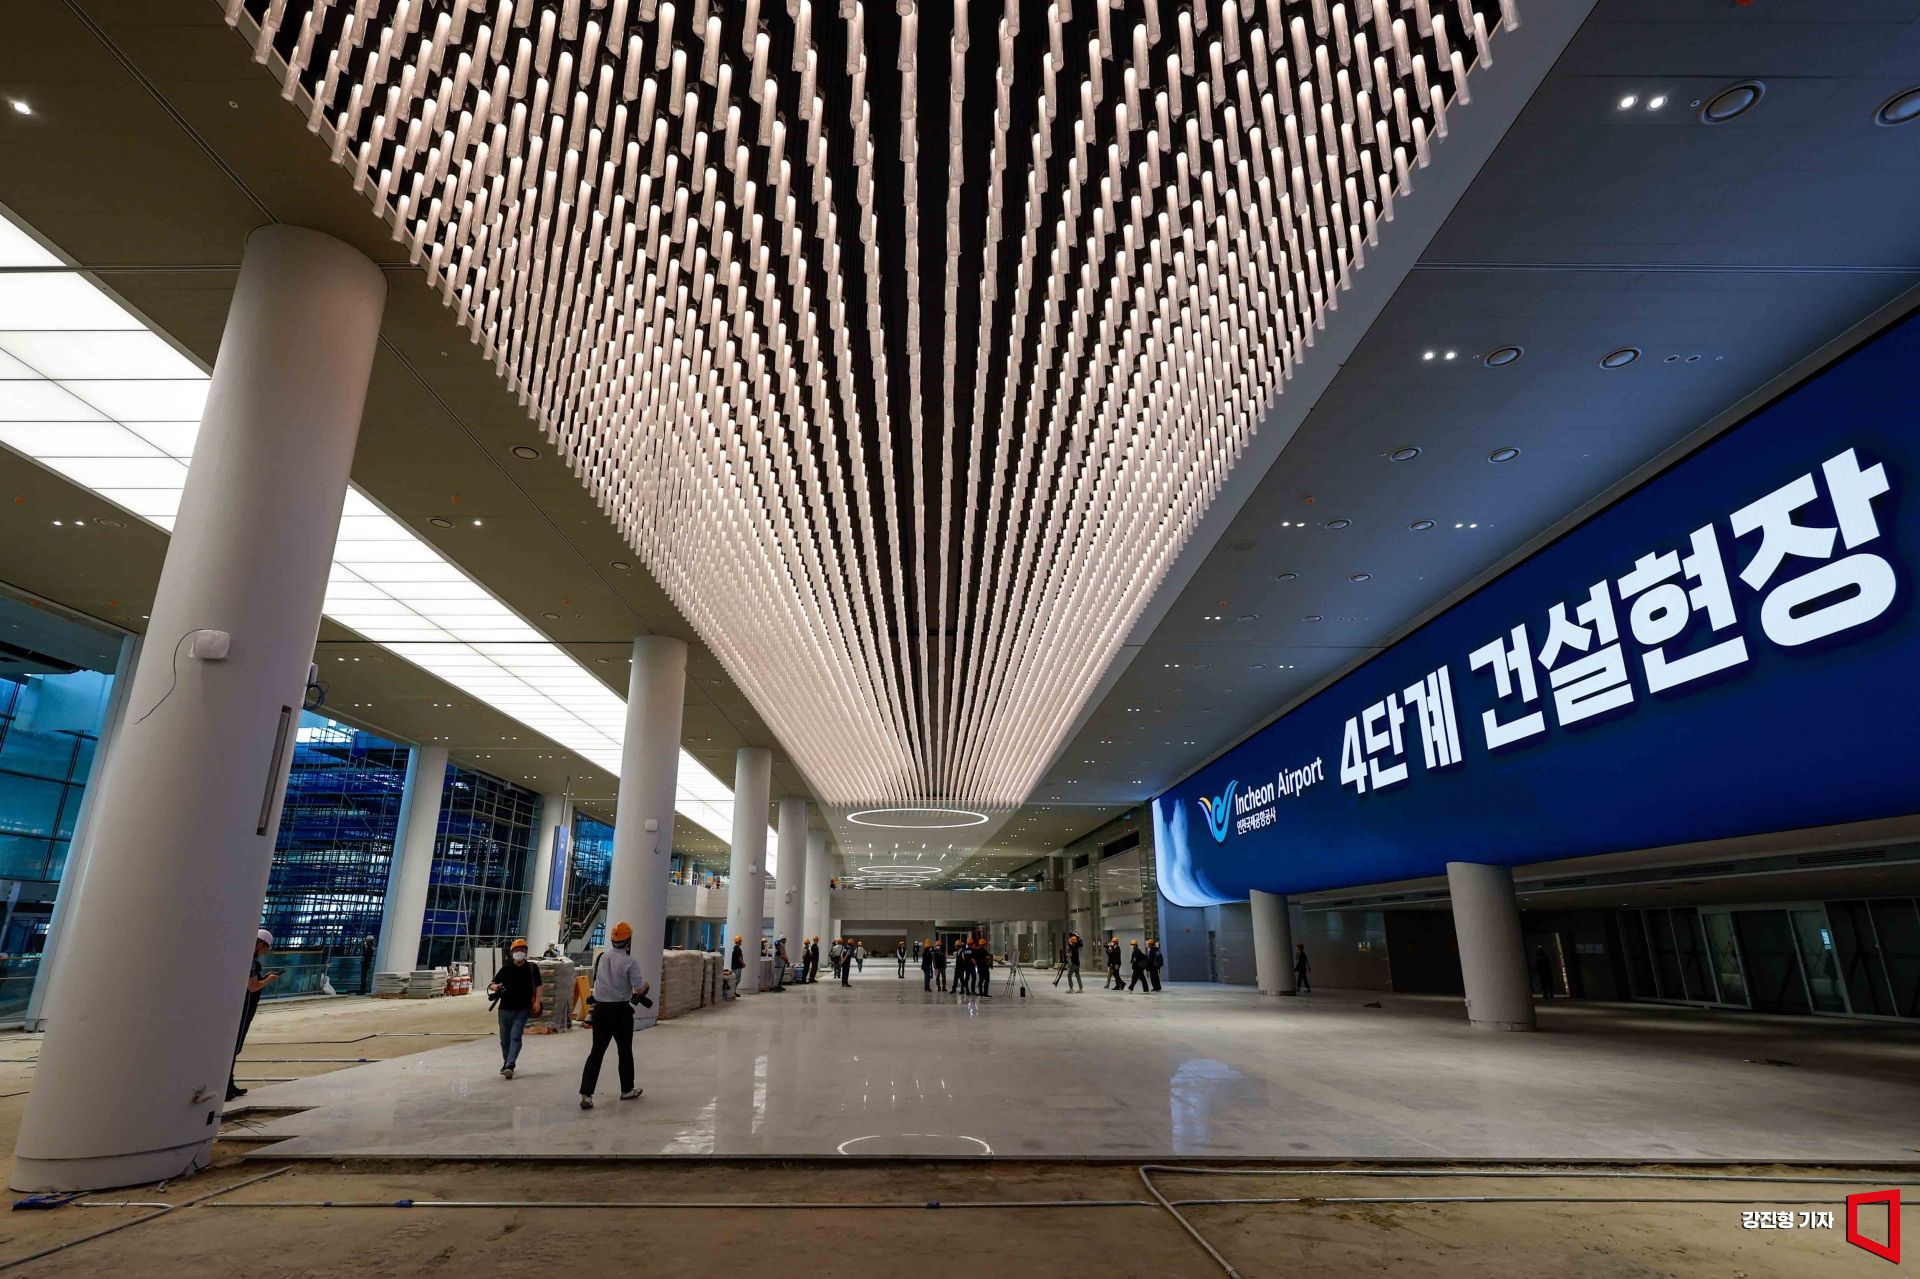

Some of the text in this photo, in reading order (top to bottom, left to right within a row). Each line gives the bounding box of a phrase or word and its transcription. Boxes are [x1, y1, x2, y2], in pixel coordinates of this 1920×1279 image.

[1340, 447, 1897, 794] 4단계 건설현장
[1235, 756, 1324, 816] Incheon Airport
